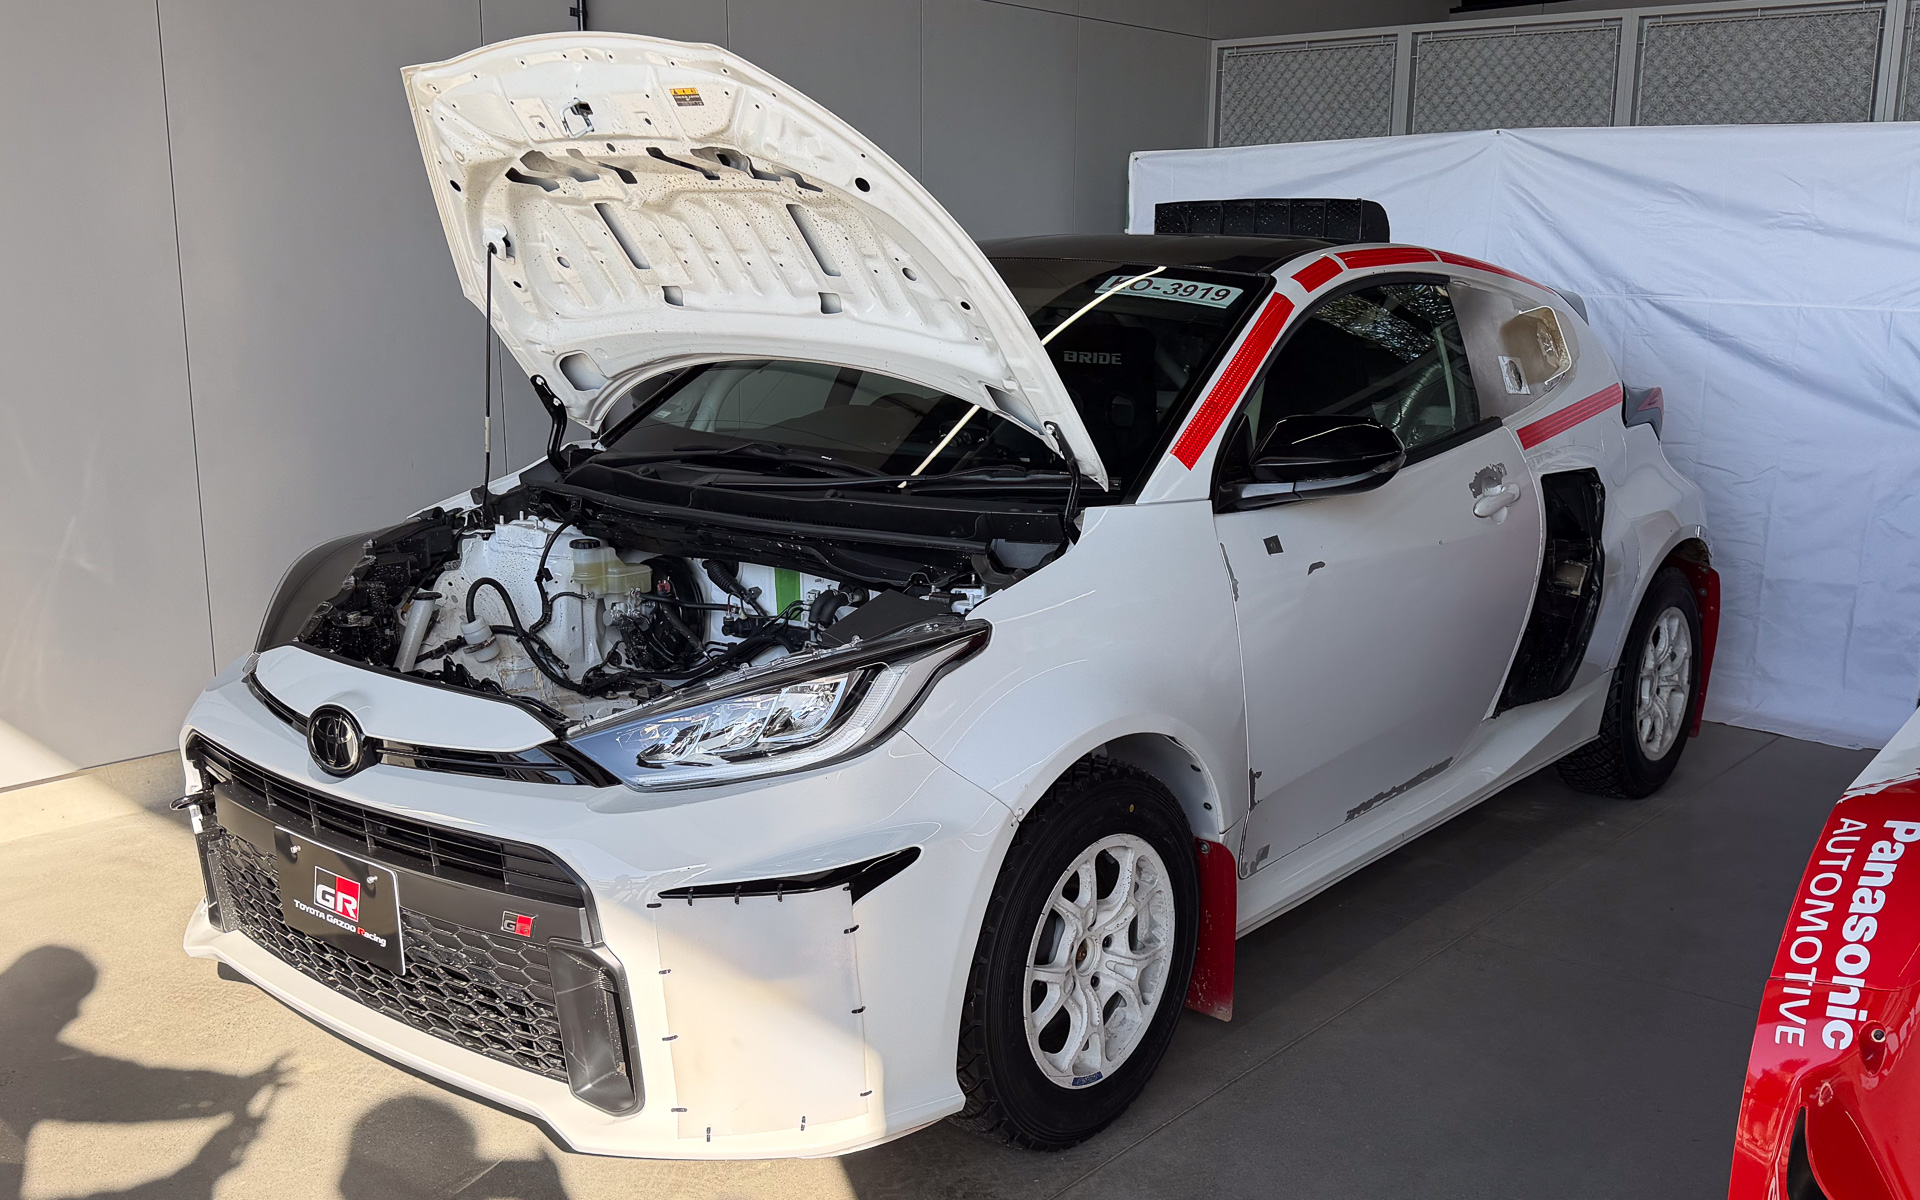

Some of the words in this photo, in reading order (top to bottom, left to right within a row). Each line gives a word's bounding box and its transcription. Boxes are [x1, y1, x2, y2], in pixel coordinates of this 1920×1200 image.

[1107, 276, 1232, 302] KO-3919
[1063, 350, 1122, 365] BRIDE
[316, 883, 358, 919] GR
[293, 898, 326, 920] TOYOTA
[326, 914, 357, 933] GAZOO
[356, 926, 387, 948] Racing
[1774, 817, 1868, 1047] AUTOMOTIVE
[1821, 819, 1920, 1050] Panasonic
